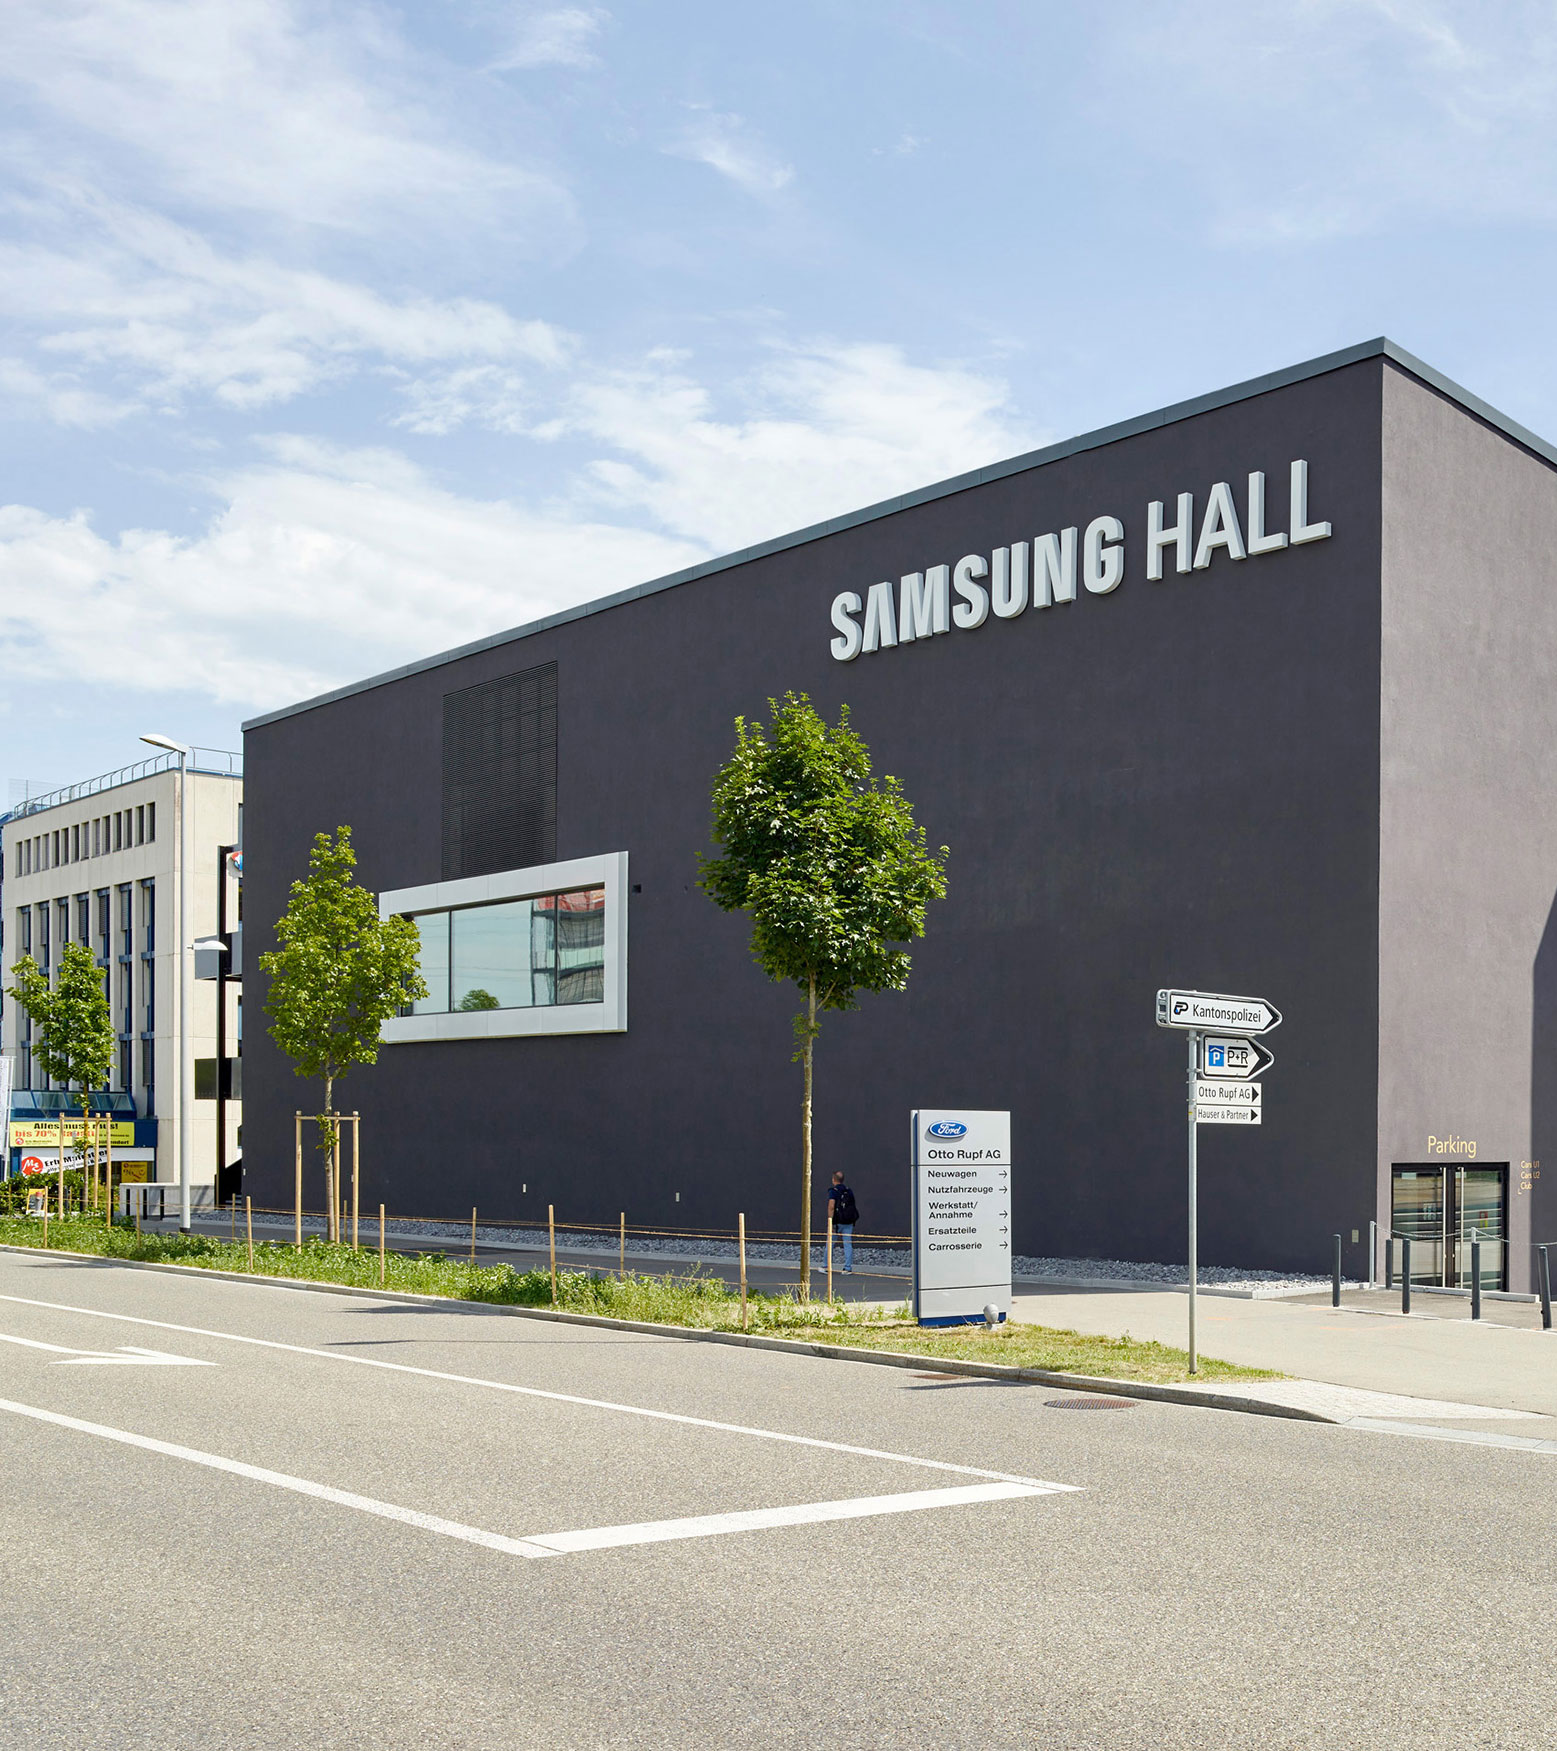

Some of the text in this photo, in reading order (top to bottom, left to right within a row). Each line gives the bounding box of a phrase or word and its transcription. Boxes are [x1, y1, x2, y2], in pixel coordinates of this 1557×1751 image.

[830, 459, 1331, 662] SAMSUNG HALL
[1192, 1003, 1261, 1023] Kantonspolizei
[1227, 1050, 1248, 1065] P+R
[1198, 1086, 1250, 1101] Otto Rupf AG
[1198, 1109, 1249, 1120] Hauser & Partner
[34, 1122, 60, 1130] Alles
[35, 1130, 57, 1138] 70%
[1427, 1134, 1477, 1159] Parking
[928, 1149, 1001, 1161] Otto Rupf AG
[928, 1170, 977, 1179] Neuwagen
[928, 1185, 994, 1194] Nutzfahrzeuge
[928, 1201, 978, 1210] Werkstatt/
[928, 1211, 973, 1219] Annahme
[928, 1226, 977, 1235] Ersatzteile
[928, 1241, 982, 1251] Carrosserie
